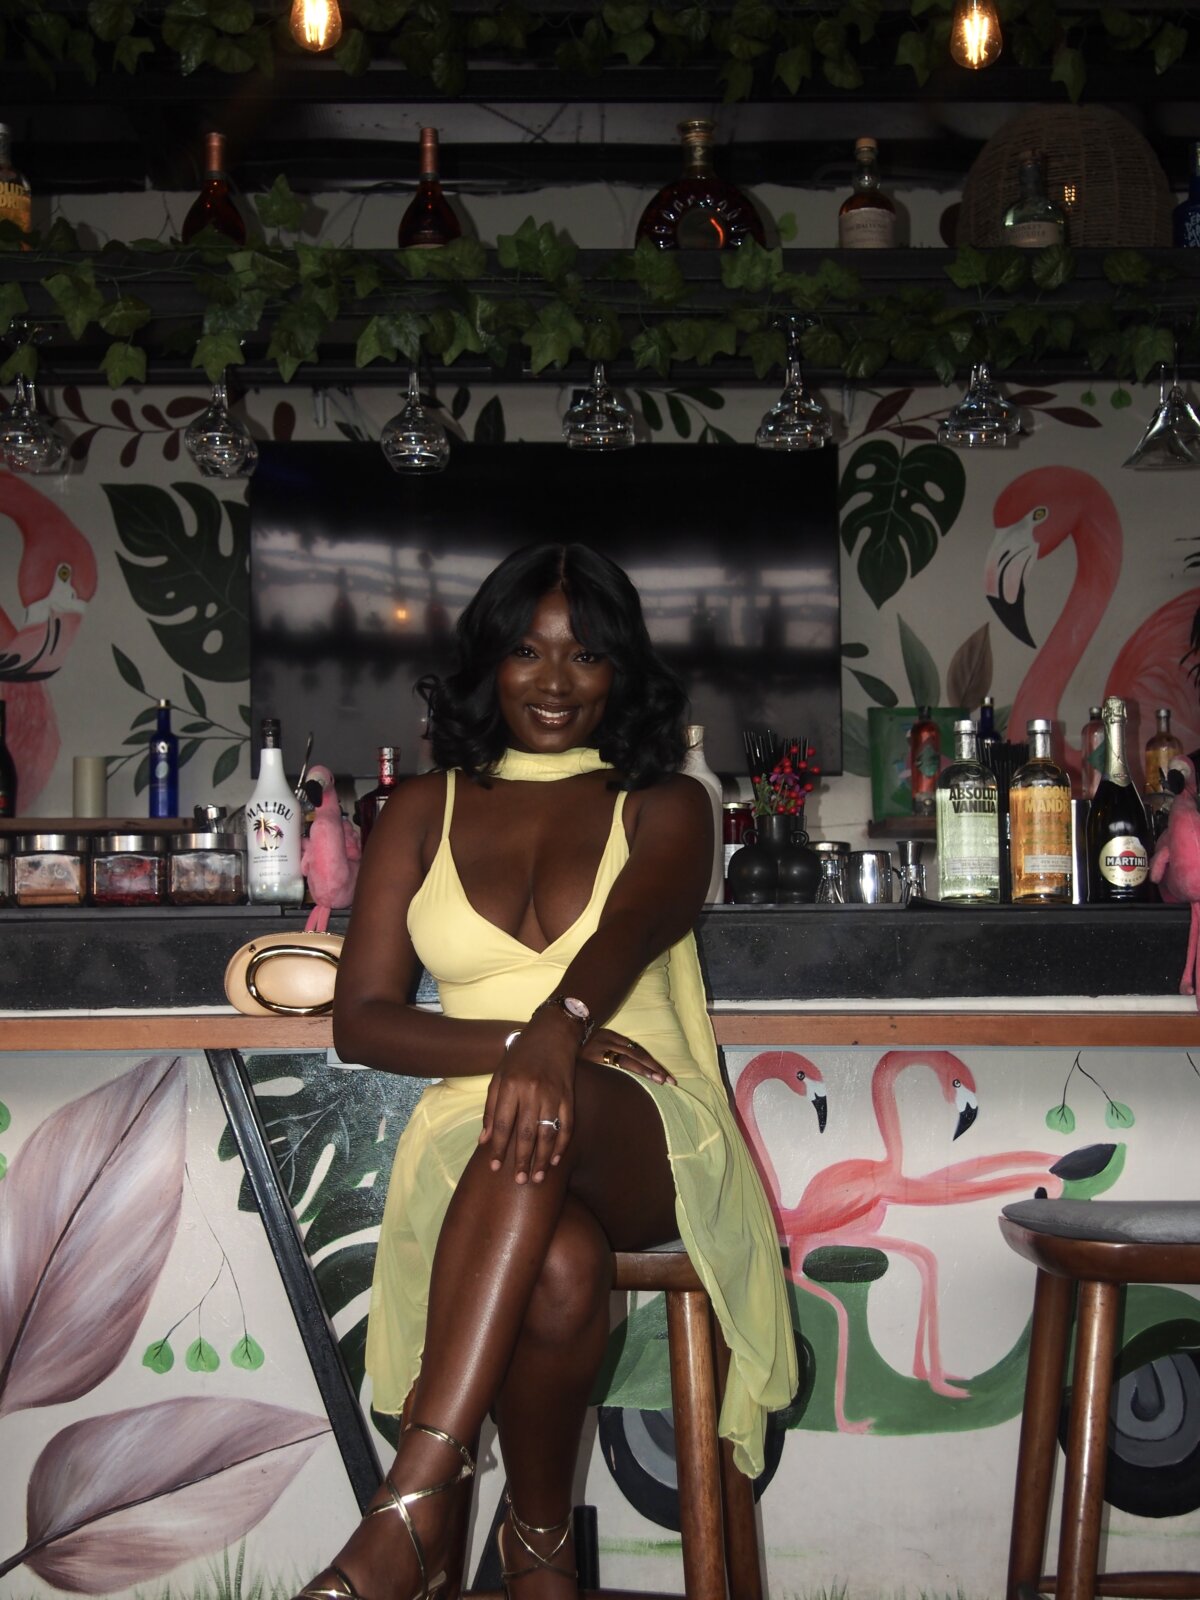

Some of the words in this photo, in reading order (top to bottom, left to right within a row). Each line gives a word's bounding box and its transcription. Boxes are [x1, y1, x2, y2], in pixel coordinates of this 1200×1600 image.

[949, 786, 997, 801] ABSOLUT
[246, 801, 294, 821] MALIBU
[952, 800, 997, 814] VANILIA
[1106, 856, 1145, 866] MARTINI
